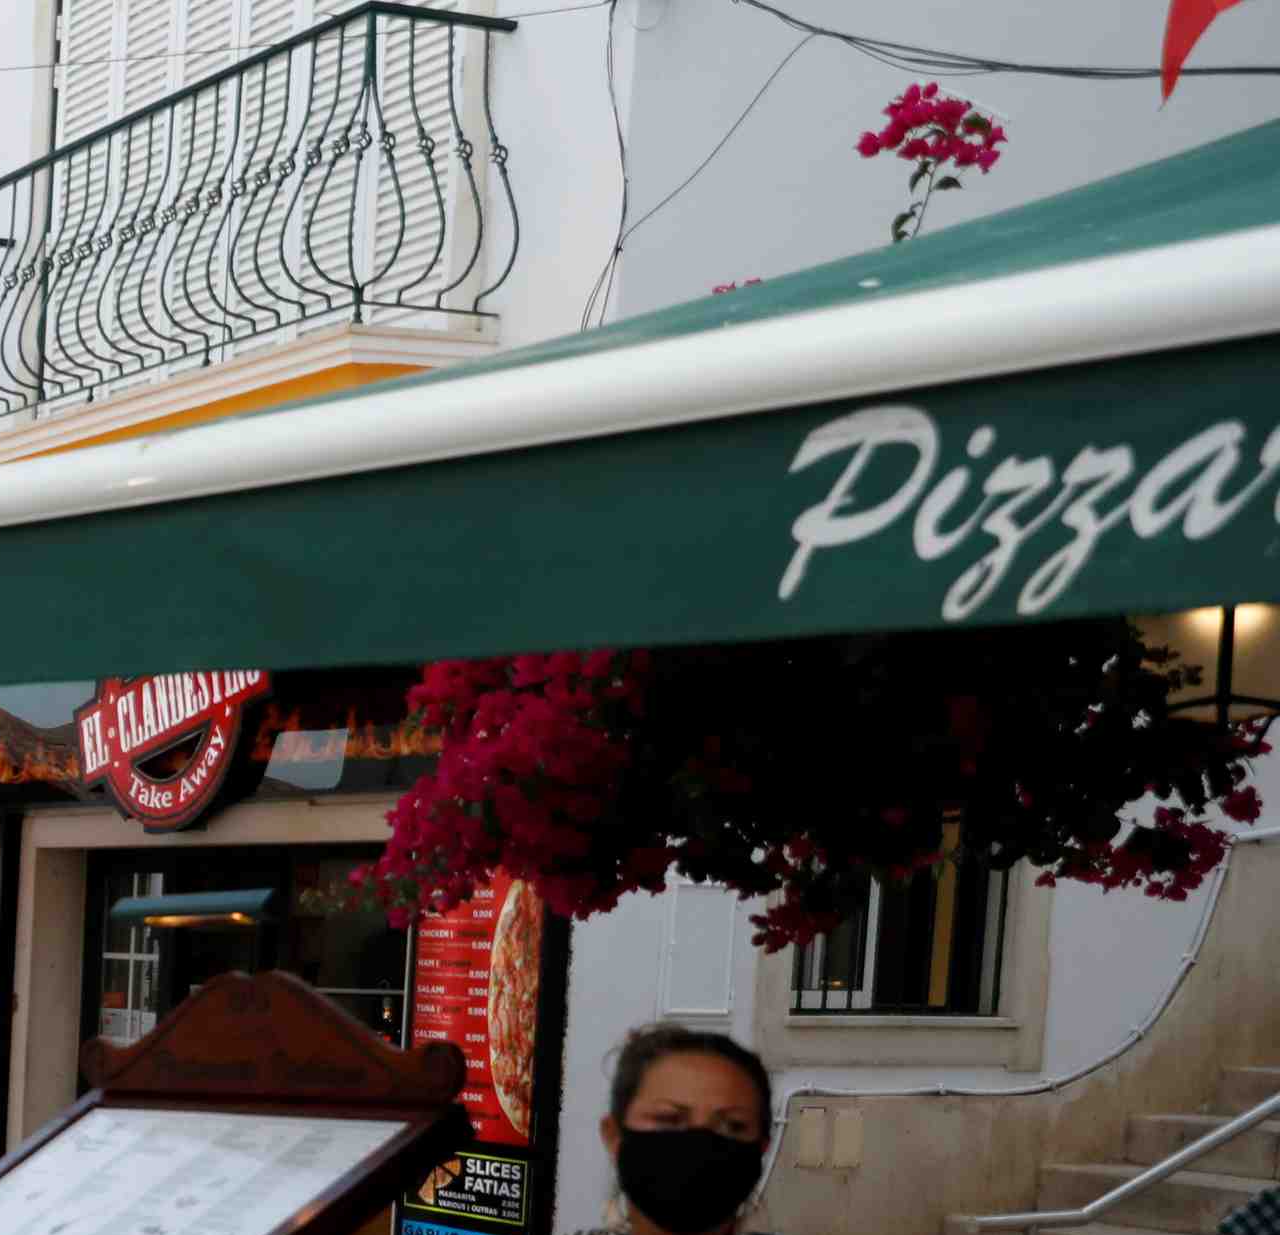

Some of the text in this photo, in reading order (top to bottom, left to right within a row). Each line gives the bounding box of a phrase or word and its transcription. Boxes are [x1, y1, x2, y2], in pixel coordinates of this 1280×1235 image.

[778, 405, 1280, 621] Pizza
[81, 711, 111, 775] EL
[128, 725, 225, 809] Take Away
[464, 1176, 521, 1199] FATIAS
[466, 1158, 521, 1180] SLICES
[438, 1189, 476, 1202] MARGARITA
